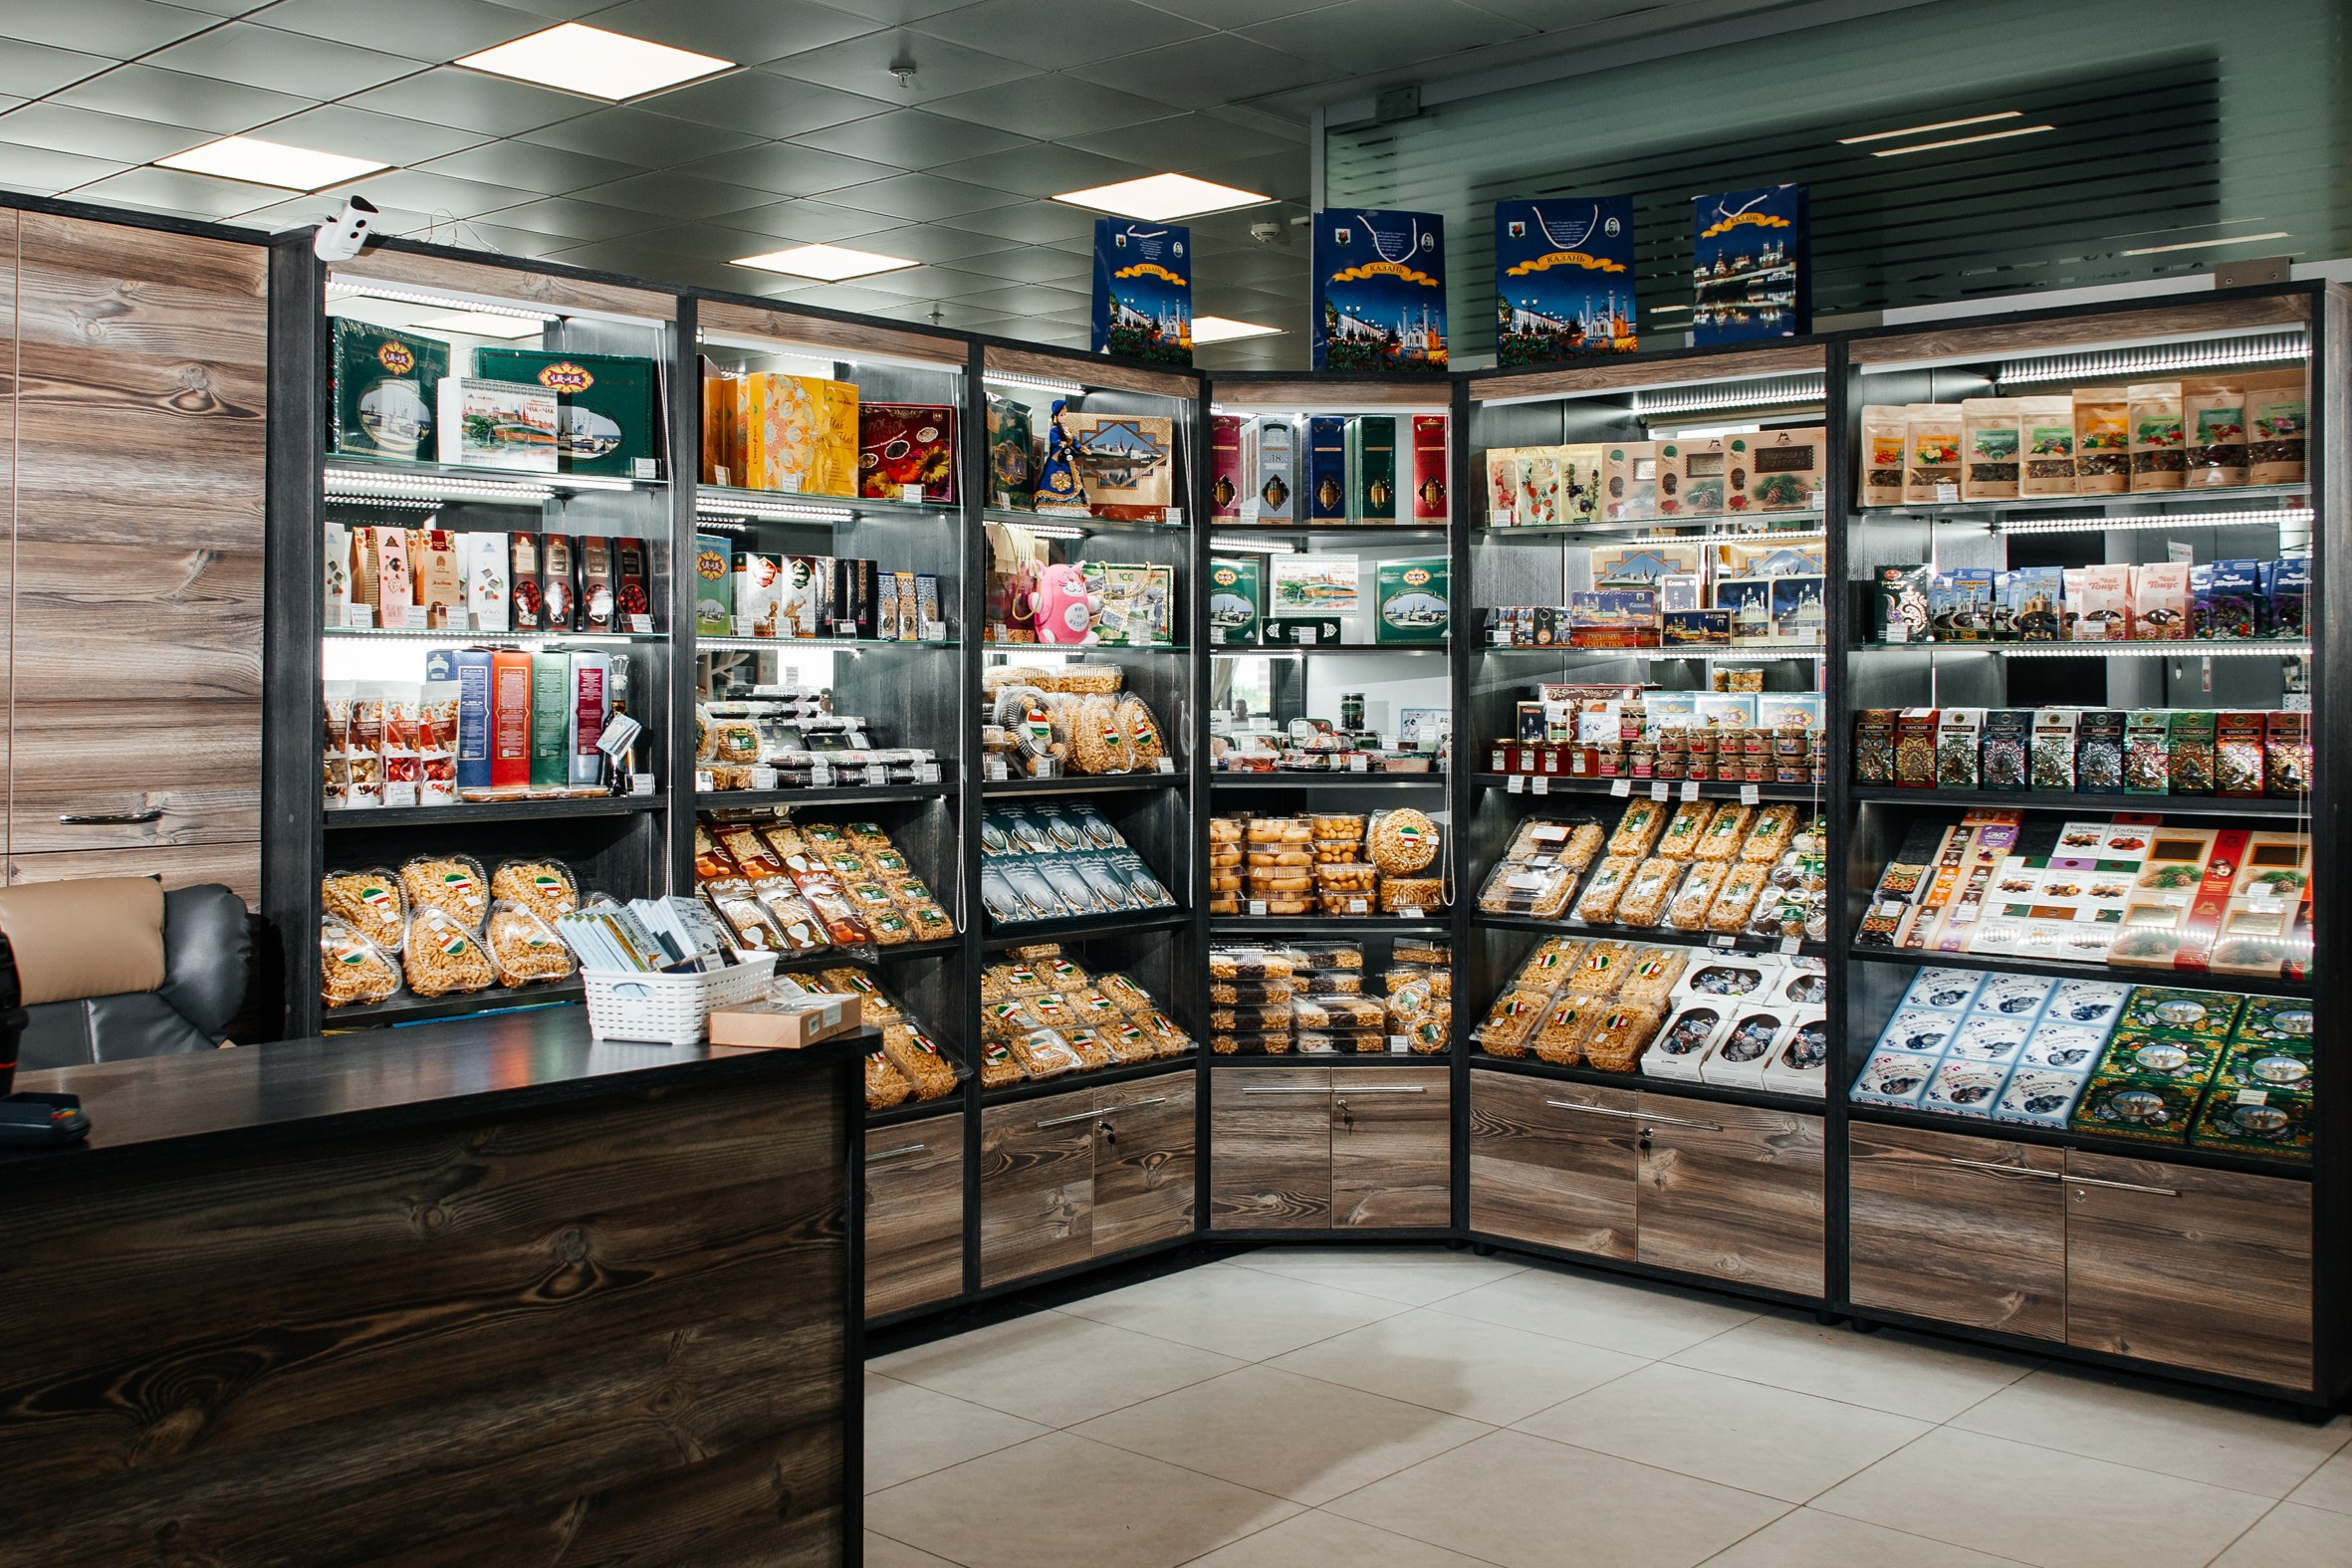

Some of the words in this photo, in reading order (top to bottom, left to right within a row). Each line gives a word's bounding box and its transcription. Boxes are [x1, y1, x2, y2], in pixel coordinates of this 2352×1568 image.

[1730, 215, 1760, 224] КАЗАНЬ
[1546, 255, 1585, 264] КАЗАНЬ
[1369, 265, 1404, 274] КАЗАНЬ
[1271, 454, 1282, 463] 18
[2088, 581, 2119, 591] Тонус
[2148, 580, 2179, 589] Тонус
